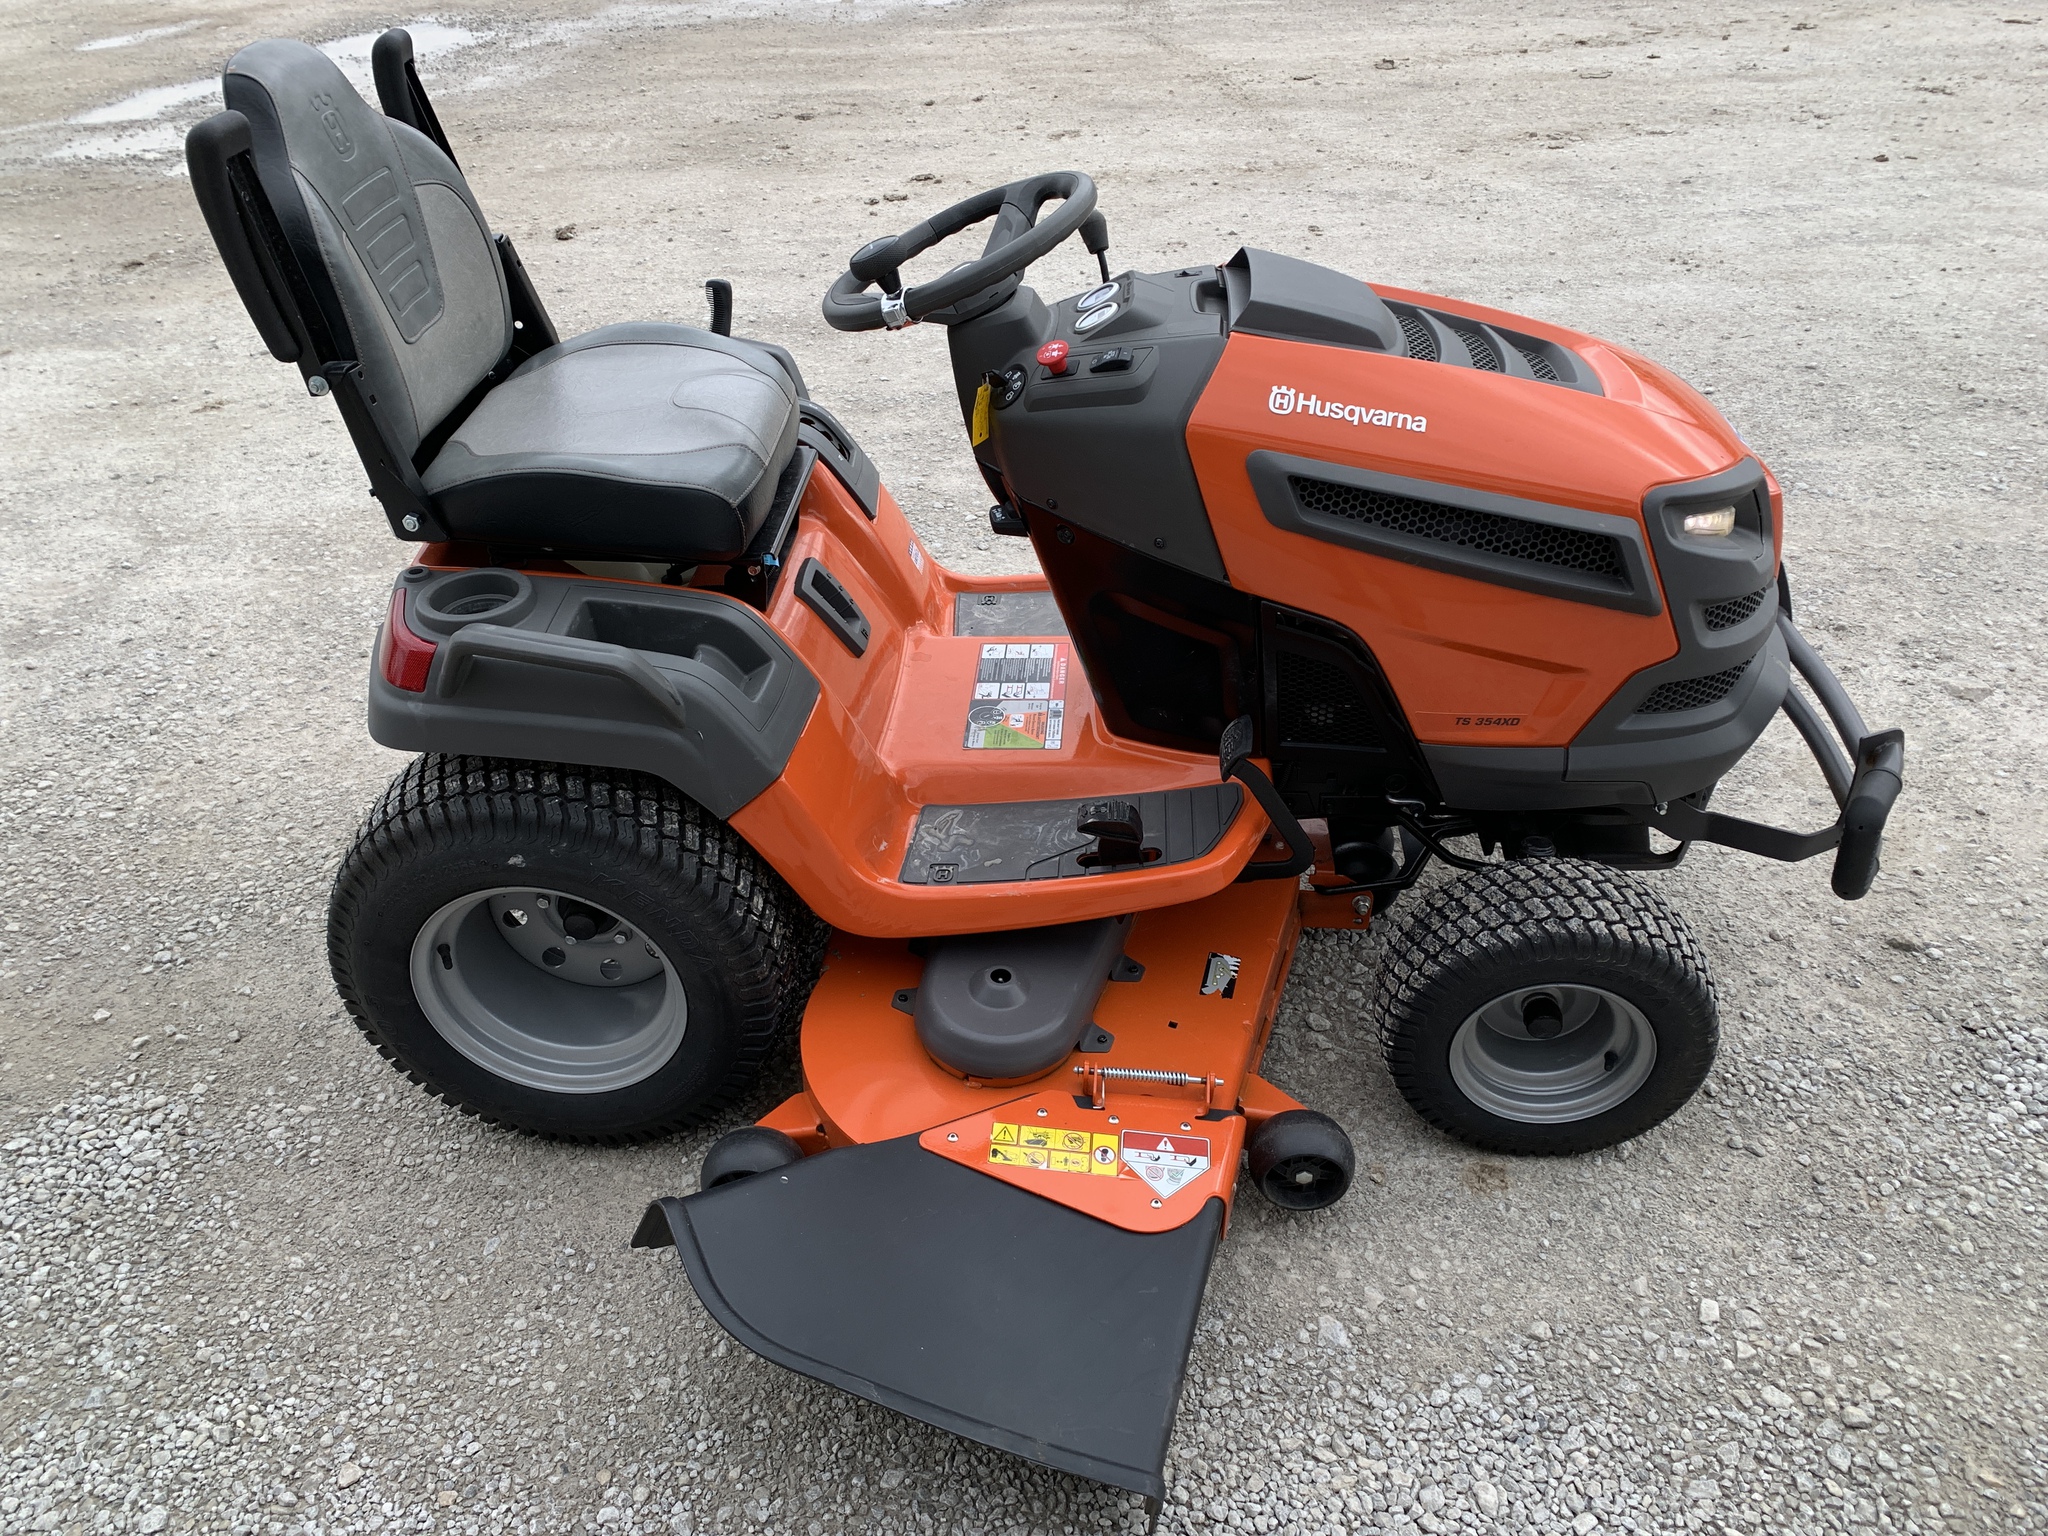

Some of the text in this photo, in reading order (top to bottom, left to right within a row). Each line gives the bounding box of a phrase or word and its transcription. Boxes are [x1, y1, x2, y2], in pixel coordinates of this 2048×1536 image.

[1296, 392, 1428, 433] Husqvarna
[1455, 717, 1521, 726] TS 354XD
